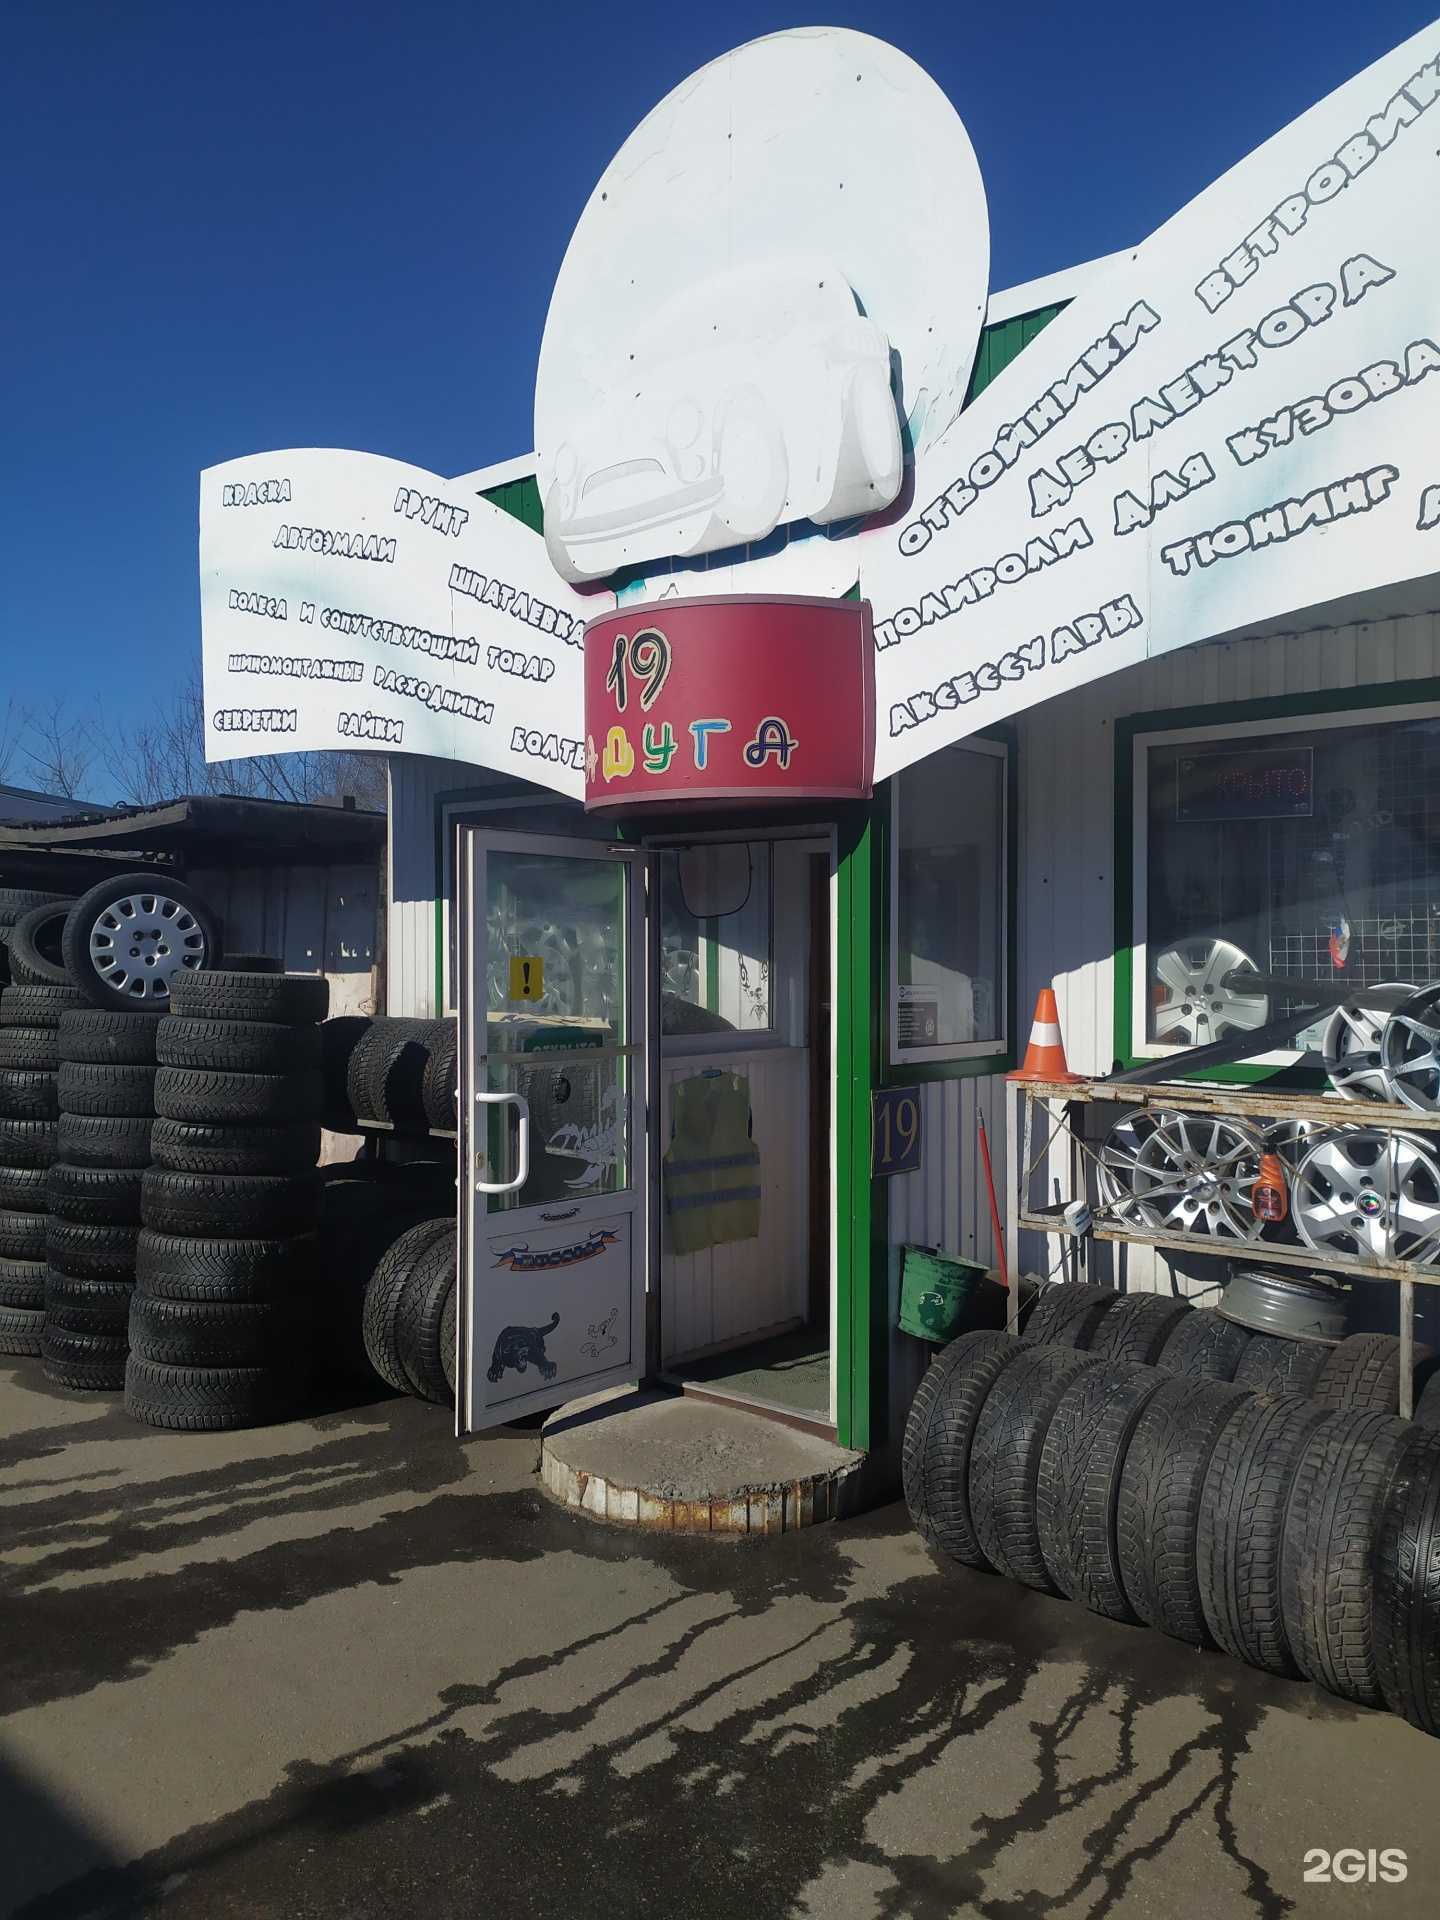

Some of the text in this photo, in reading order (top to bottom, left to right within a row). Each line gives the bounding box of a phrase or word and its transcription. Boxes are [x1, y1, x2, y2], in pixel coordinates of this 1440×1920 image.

[1028, 254, 1397, 518] ДЕФЛЕКТОРА
[898, 299, 1161, 557] ОТБОЙНИКИ
[223, 479, 291, 507] КРАСКА
[394, 487, 469, 537] ГРУНТ
[873, 338, 1440, 652] ПОЛИРОЛИ ДЛЯ КУЗОВА
[1160, 464, 1400, 576] ТЮНИНГ
[272, 524, 397, 563] АВТОЭМАЛИ
[228, 589, 555, 683] КОЛЕСА И СОПУТСТВУЮЩИЙ ТОВАР
[448, 563, 586, 651] ШПАТЛЕВКА
[228, 654, 494, 725] ШИНОМОНТАЖНЫЕ РАСХОДНИКИ
[607, 627, 671, 711] 19
[213, 708, 297, 732] СЕКРЕТКИ
[337, 710, 404, 744] ГАЙКИ
[879, 1098, 918, 1164] 19
